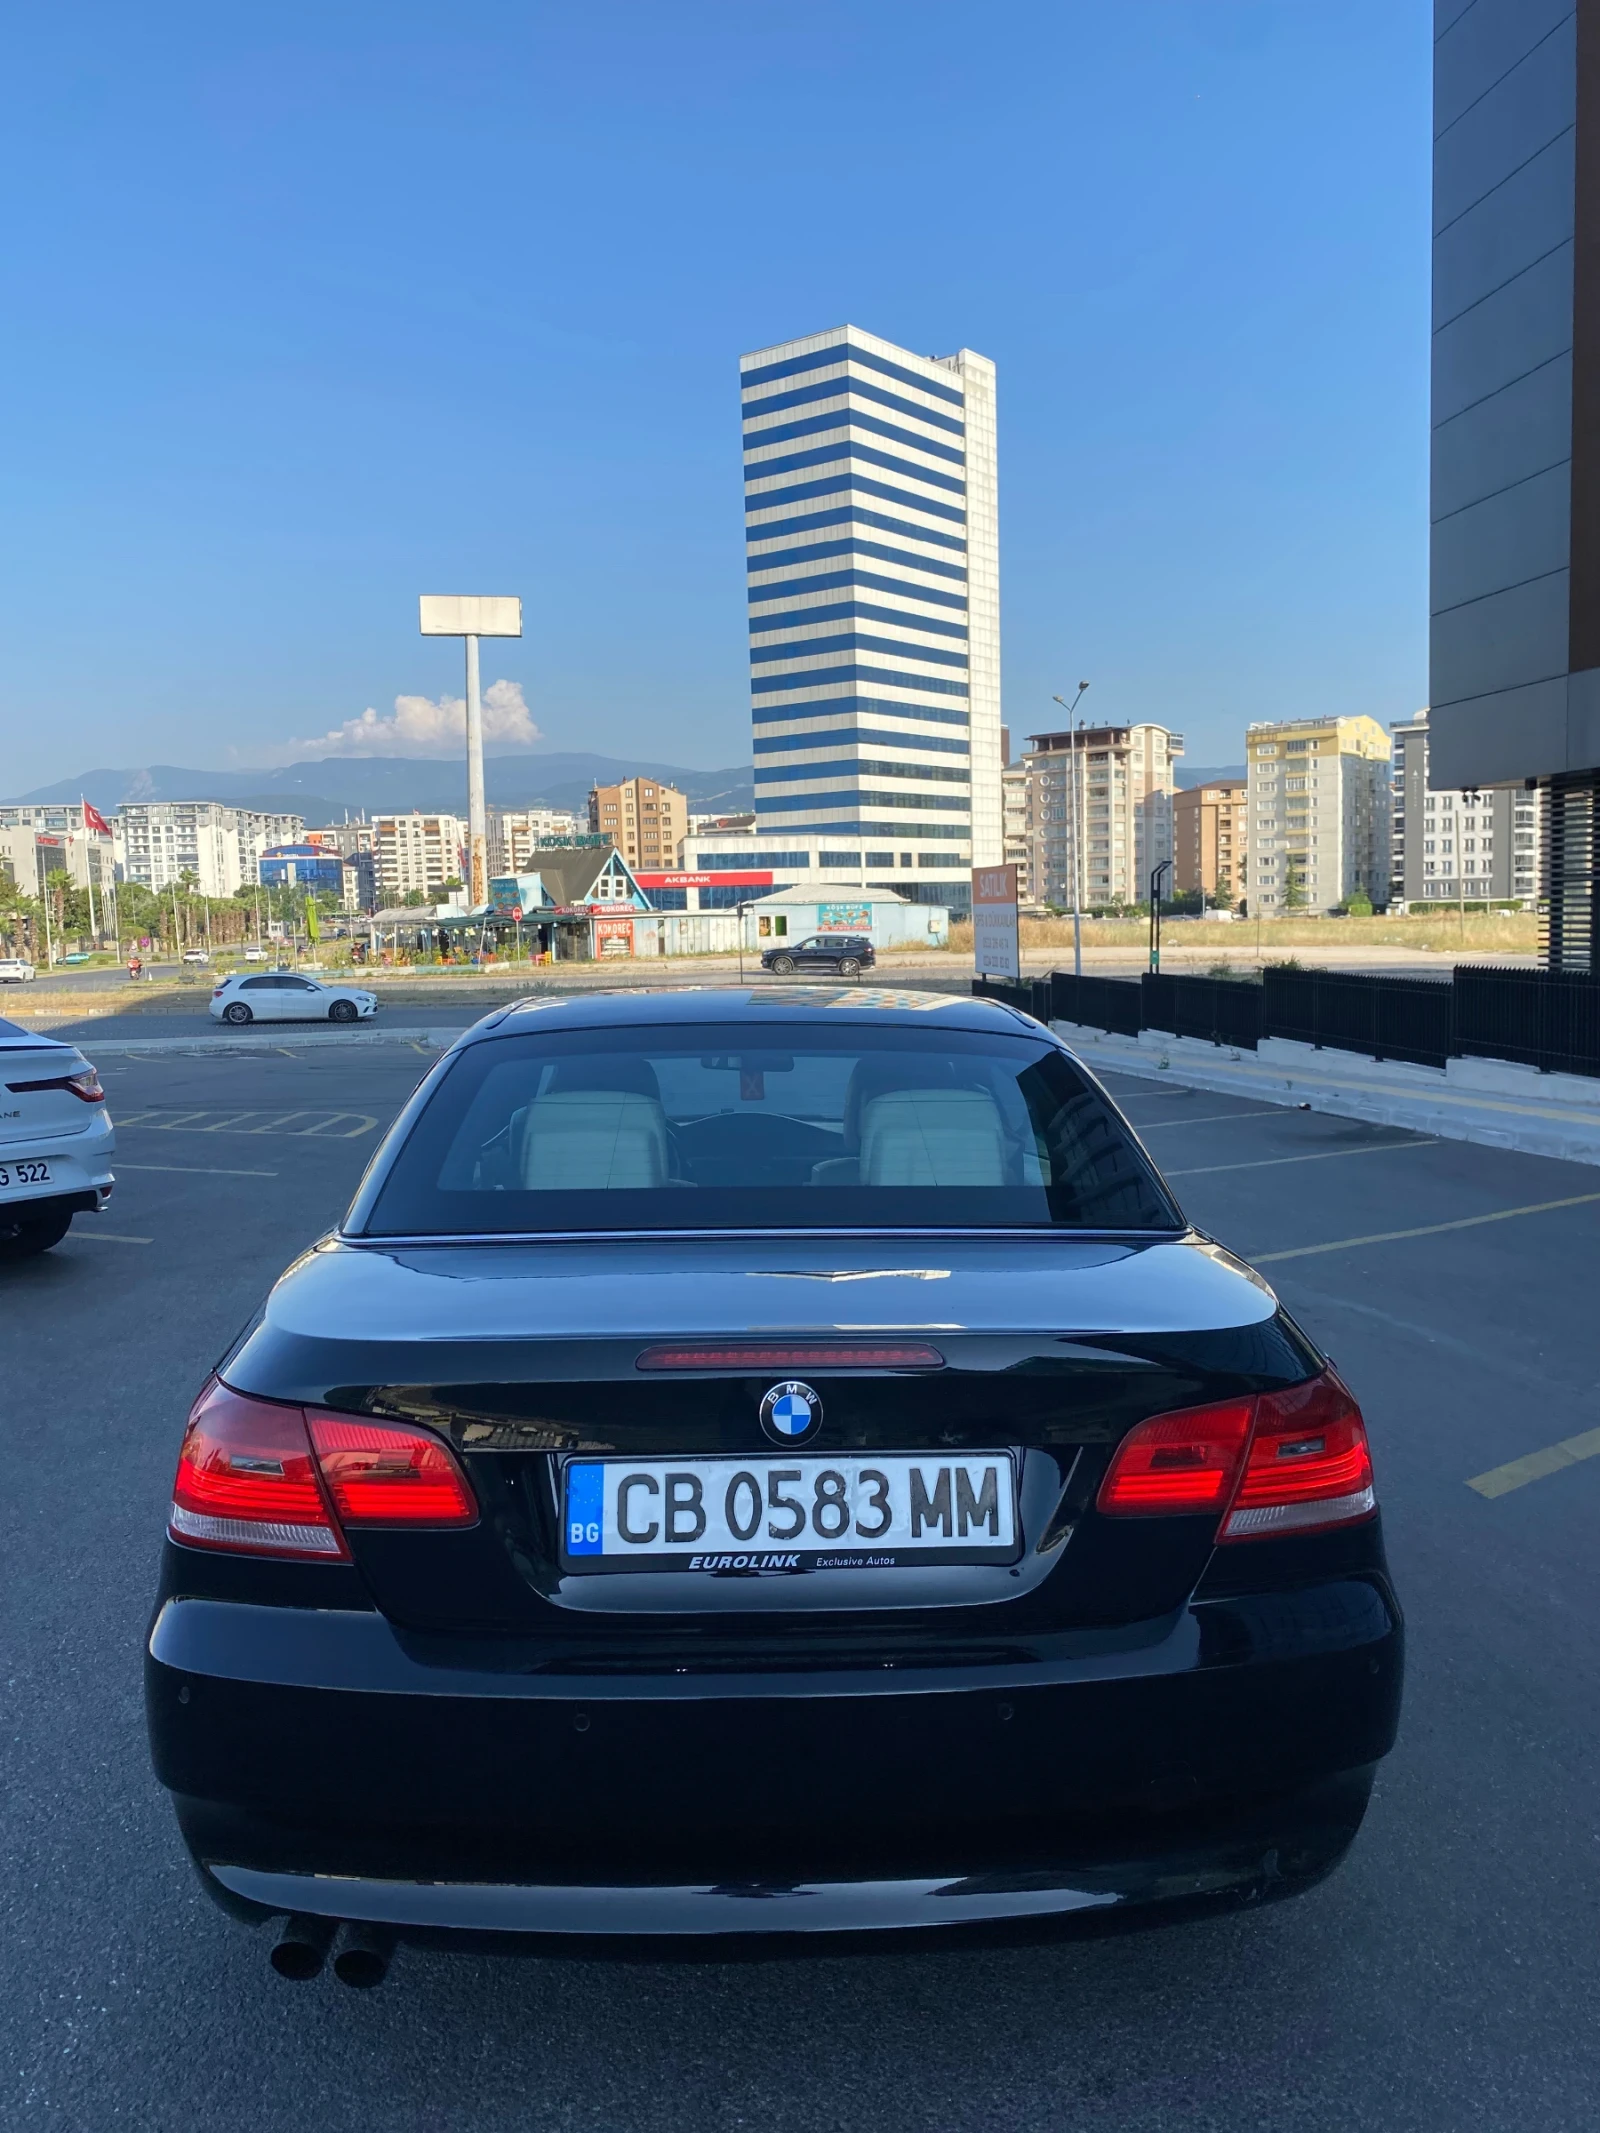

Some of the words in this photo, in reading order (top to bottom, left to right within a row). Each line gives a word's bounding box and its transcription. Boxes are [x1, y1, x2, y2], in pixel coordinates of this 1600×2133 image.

[664, 875, 710, 884] AKBANK
[979, 872, 1008, 897] SATILIK
[0, 1110, 21, 1119] NE
[16, 1162, 50, 1183] 522
[767, 1384, 817, 1404] BMW
[616, 1471, 707, 1544] CB
[724, 1469, 893, 1542] 0583
[909, 1466, 1000, 1538] MM
[570, 1523, 600, 1544] BG
[688, 1554, 802, 1570] EUROLINK
[816, 1556, 863, 1567] Exclusive
[865, 1556, 896, 1566] Autos
